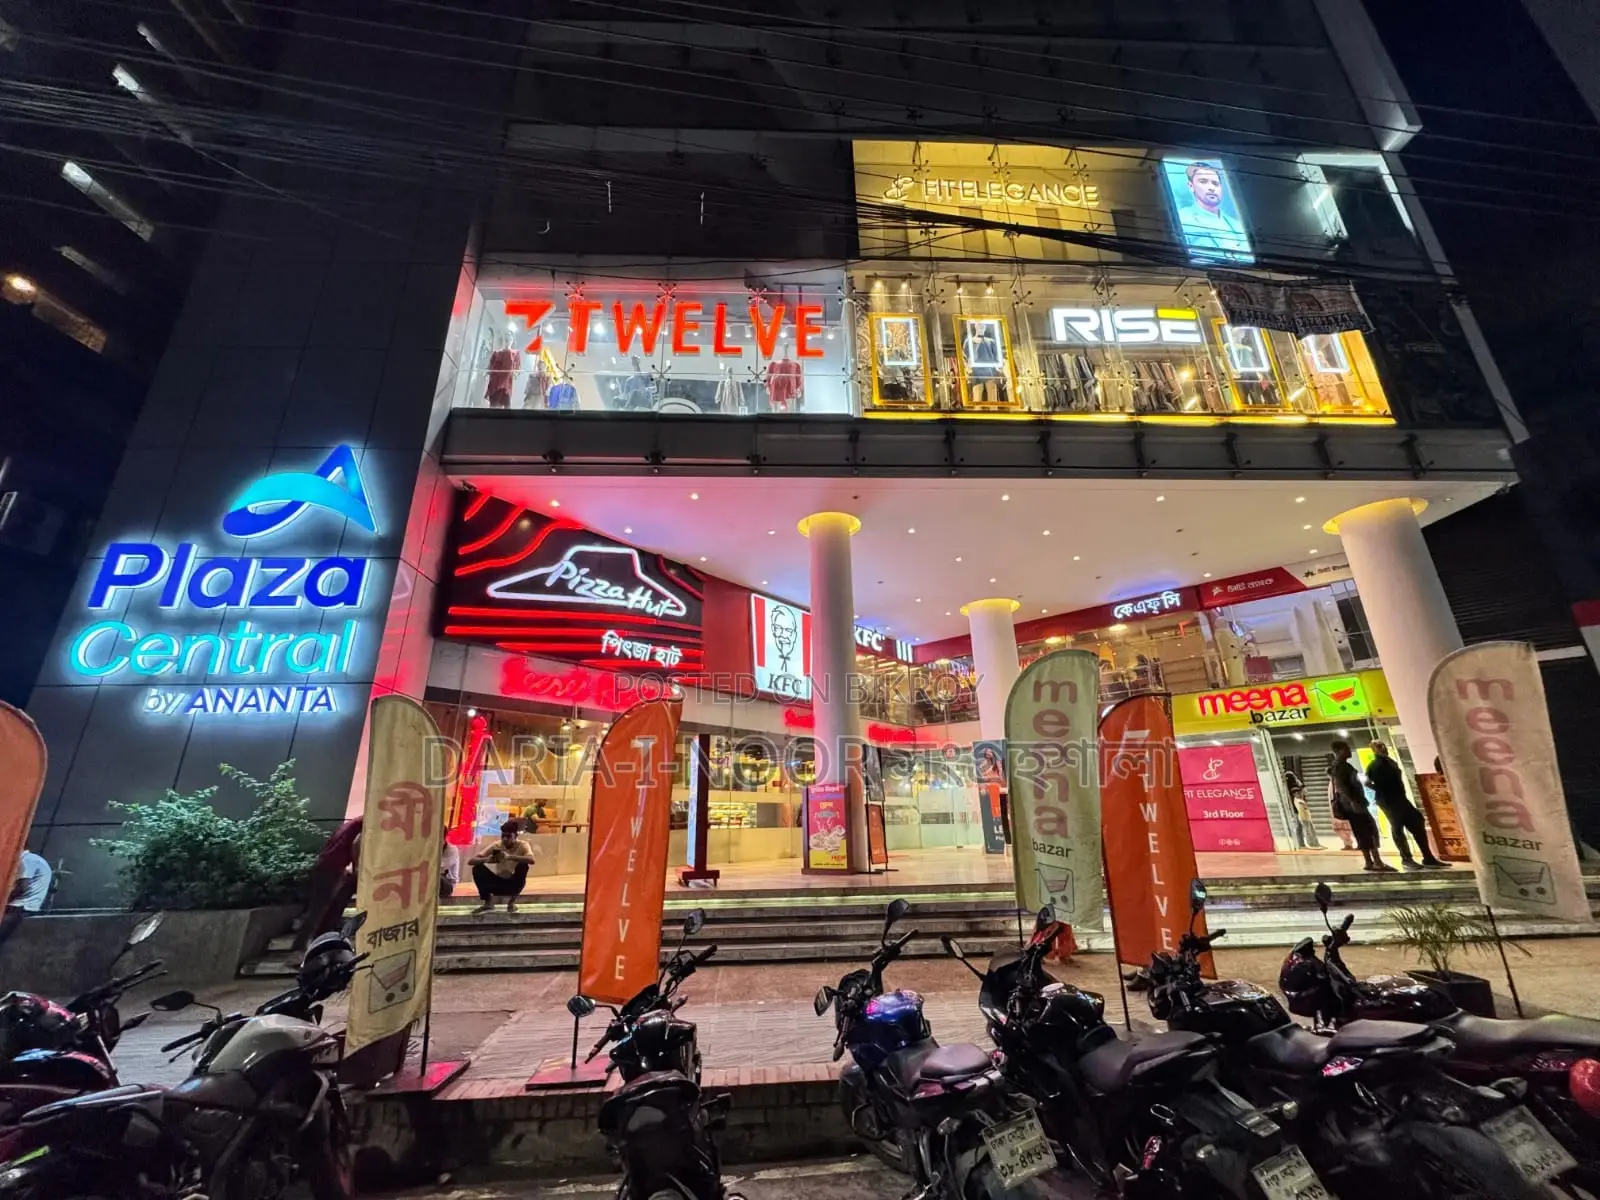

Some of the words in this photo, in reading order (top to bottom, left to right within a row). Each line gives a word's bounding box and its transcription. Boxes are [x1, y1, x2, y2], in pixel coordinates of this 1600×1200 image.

[569, 301, 825, 359] TWELVE
[1051, 307, 1202, 343] RISE
[88, 542, 371, 610] Plaza
[545, 560, 625, 601] Pizza
[627, 585, 676, 618] Hut
[70, 620, 359, 677] Central
[601, 629, 653, 662] পিৎজা
[655, 645, 683, 668] হাট
[854, 624, 883, 652] KFC
[144, 687, 187, 714] by
[185, 686, 336, 713] ANANTA
[768, 673, 803, 695] KFC
[1198, 683, 1309, 716] meena
[1033, 679, 1077, 839] meena
[1456, 678, 1536, 833] meena
[1196, 787, 1254, 799] ELEGANCE
[1203, 810, 1219, 818] 3rd
[1220, 810, 1244, 818] Floor
[1032, 837, 1072, 859] bazar
[1482, 832, 1543, 851] bazar
[367, 917, 420, 949] বাজার
